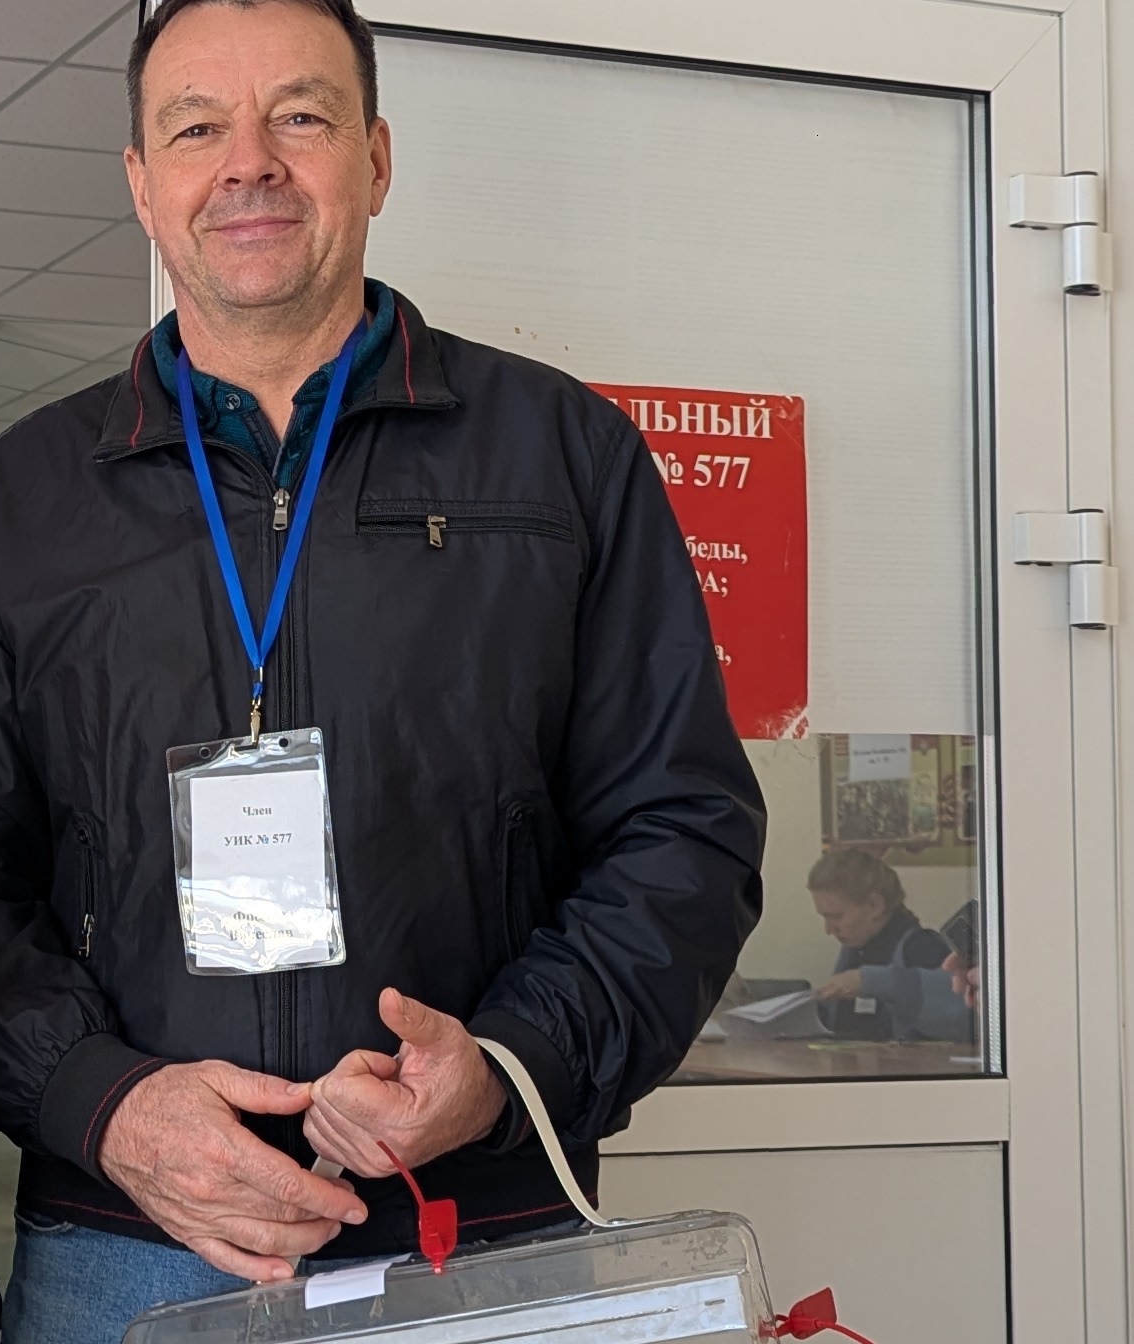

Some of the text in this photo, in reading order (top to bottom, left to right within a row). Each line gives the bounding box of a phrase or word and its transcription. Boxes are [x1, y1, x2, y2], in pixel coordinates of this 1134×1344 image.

[608, 398, 774, 439] ЛЬНЫЙ
[651, 452, 751, 489] № 577
[242, 806, 272, 817] Член
[224, 835, 253, 847] УИК
[272, 833, 292, 844] 577
